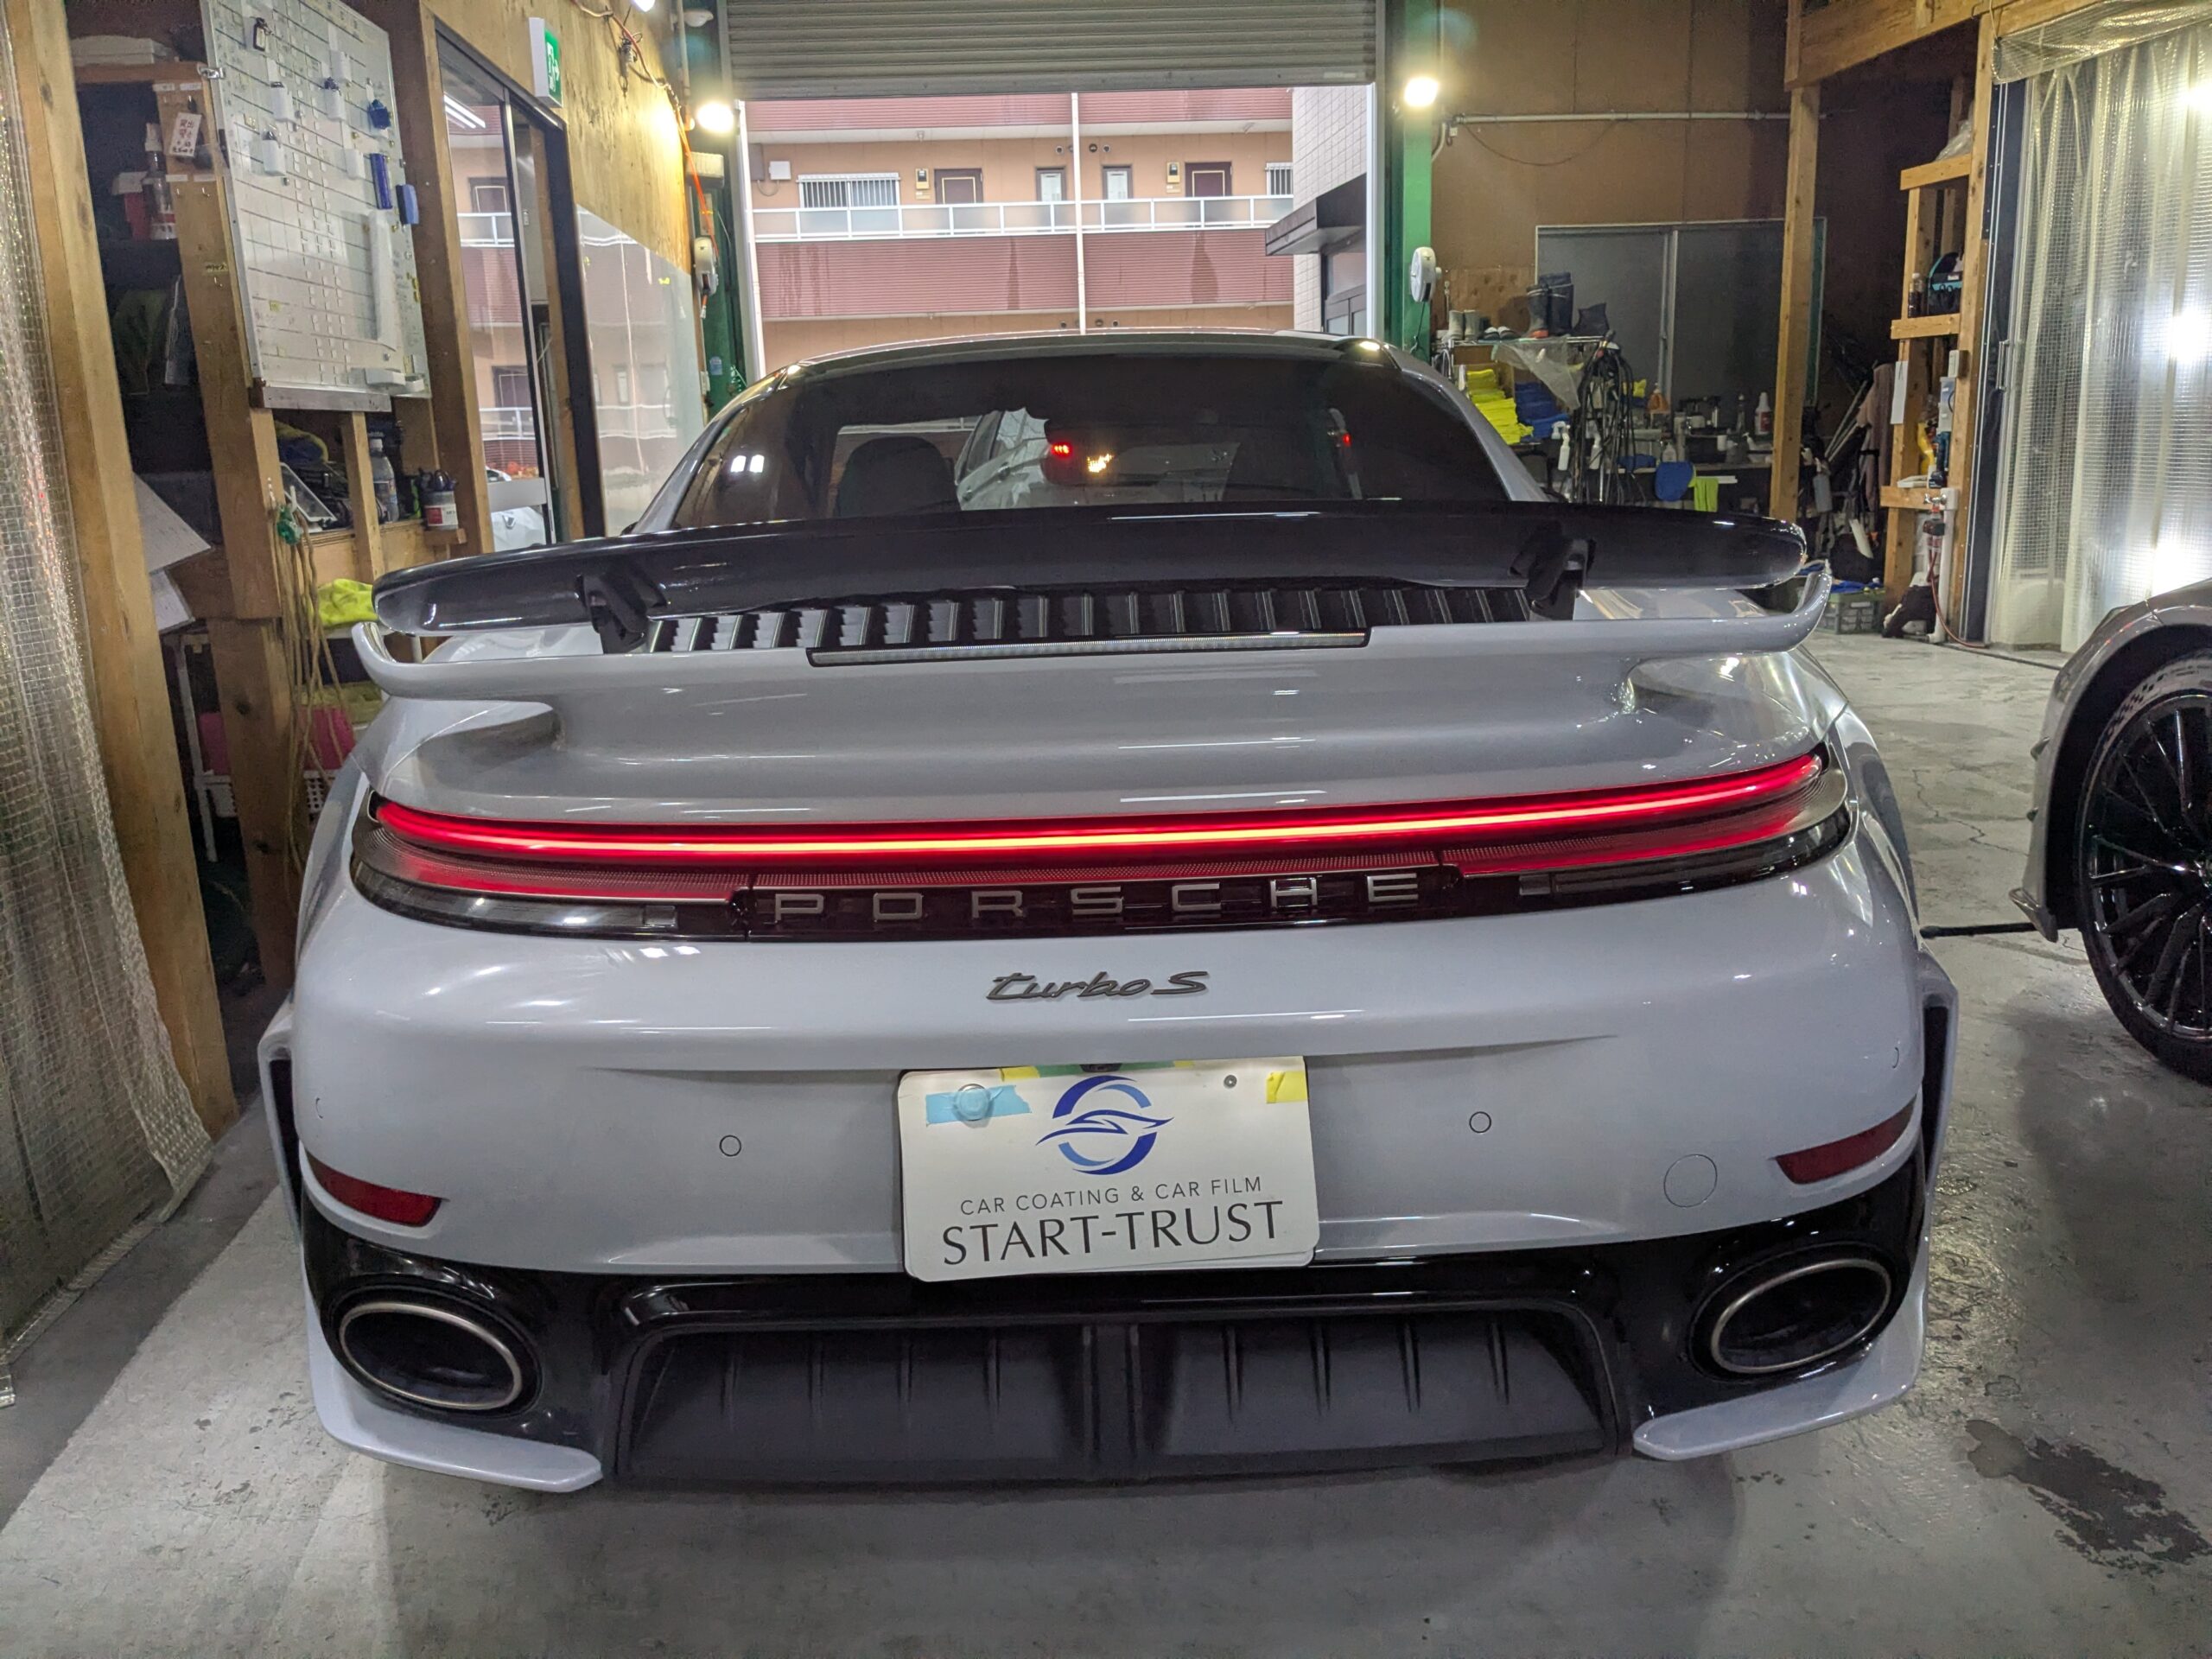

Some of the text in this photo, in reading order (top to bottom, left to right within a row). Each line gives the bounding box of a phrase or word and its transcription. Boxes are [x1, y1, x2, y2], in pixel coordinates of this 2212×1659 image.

[774, 873, 1419, 925] PORSCHE
[960, 1175, 1262, 1216] CAR COATING & CAR FILM
[942, 1200, 1283, 1266] START-TRUST
